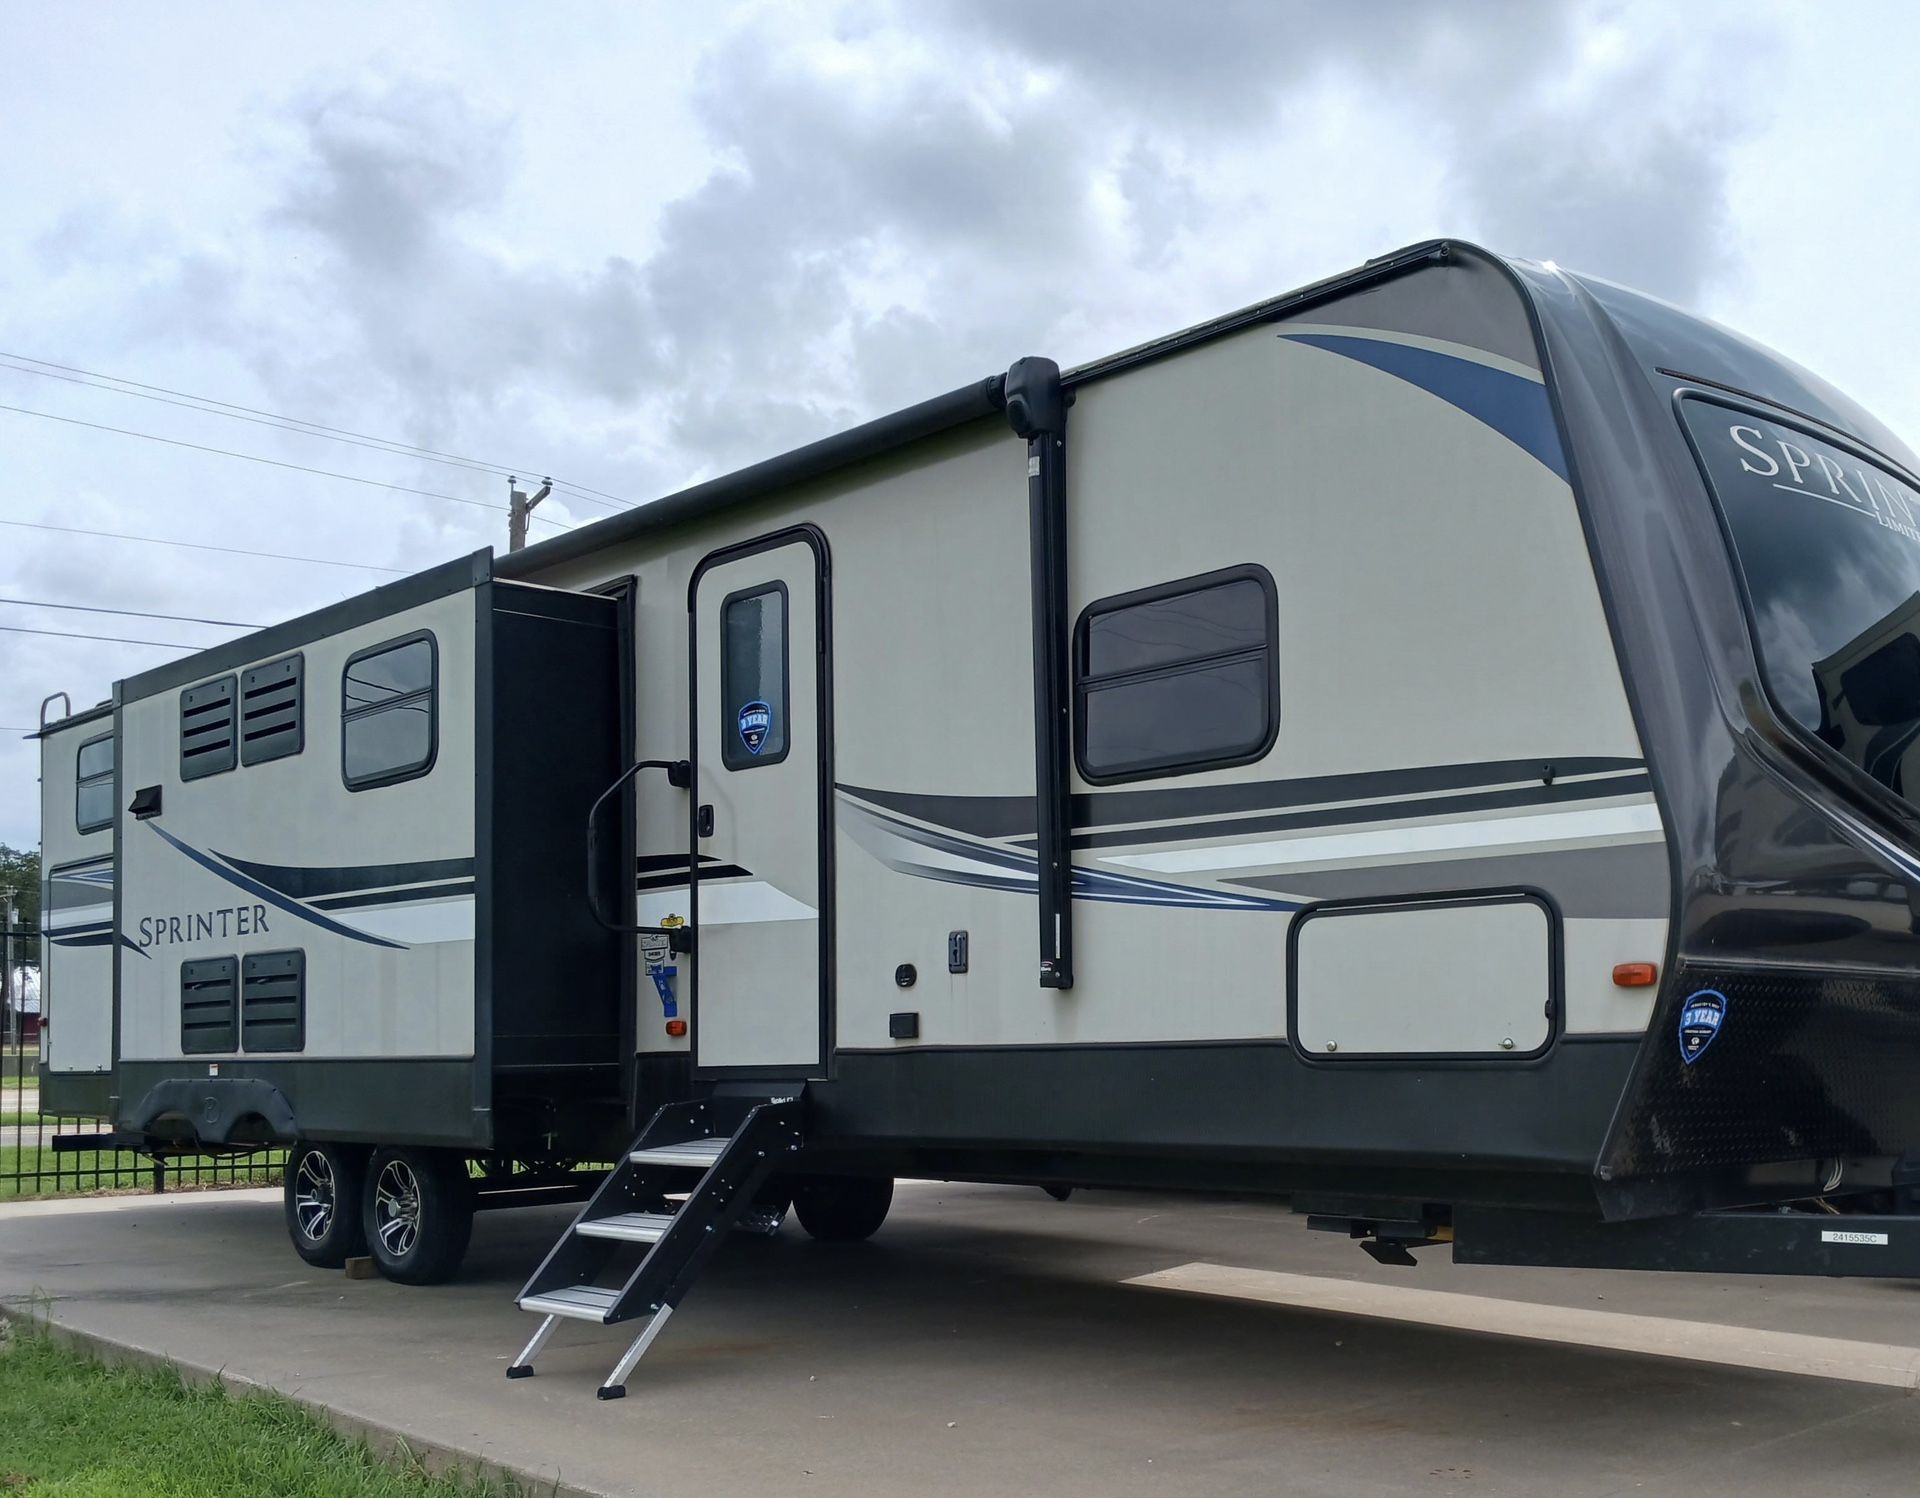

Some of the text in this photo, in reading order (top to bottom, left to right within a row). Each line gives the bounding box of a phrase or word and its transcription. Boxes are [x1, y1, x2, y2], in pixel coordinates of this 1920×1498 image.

[1729, 424, 1920, 527] SPRIN
[747, 713, 768, 727] YEAR
[139, 904, 270, 948] SPRINTER
[1684, 1008, 1720, 1027] 3 YEAR
[1832, 1232, 1877, 1243] 2415535C
